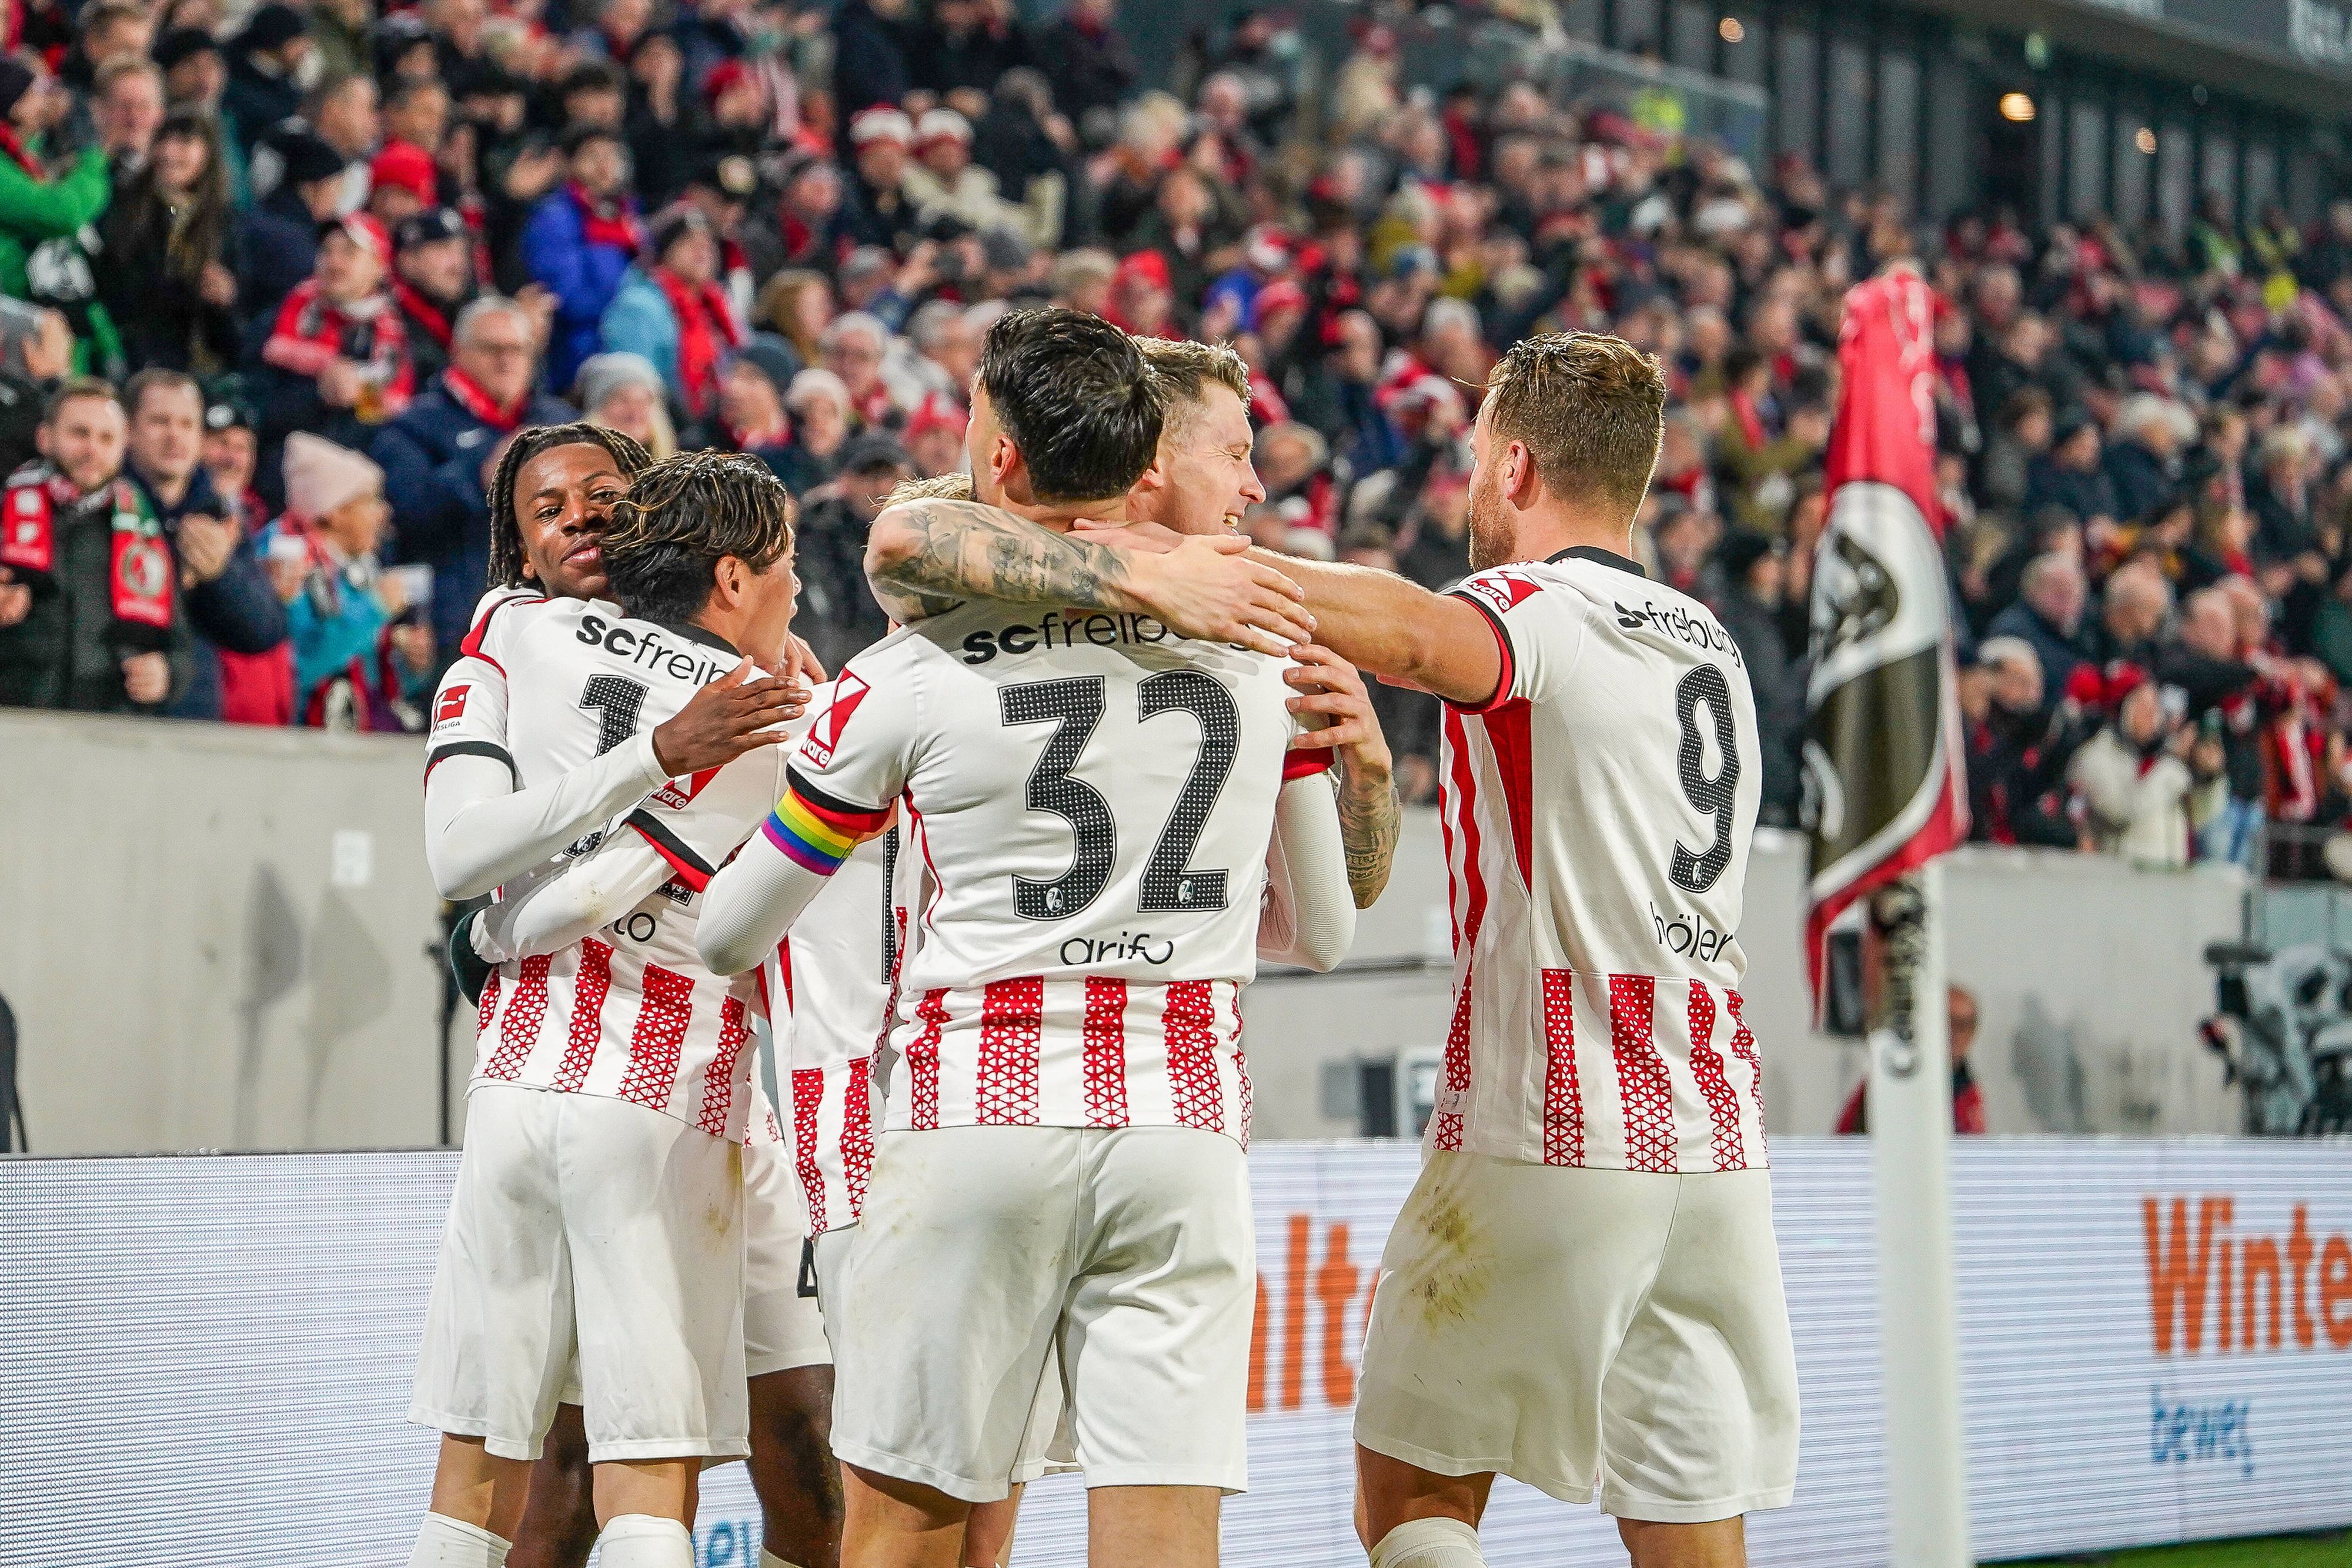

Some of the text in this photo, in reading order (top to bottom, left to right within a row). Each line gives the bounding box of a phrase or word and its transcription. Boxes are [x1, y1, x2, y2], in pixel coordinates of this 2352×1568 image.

[962, 611, 1255, 665] scfreib
[997, 669, 1241, 921] 32
[1669, 663, 1741, 894] 9
[1649, 901, 1734, 963] höler
